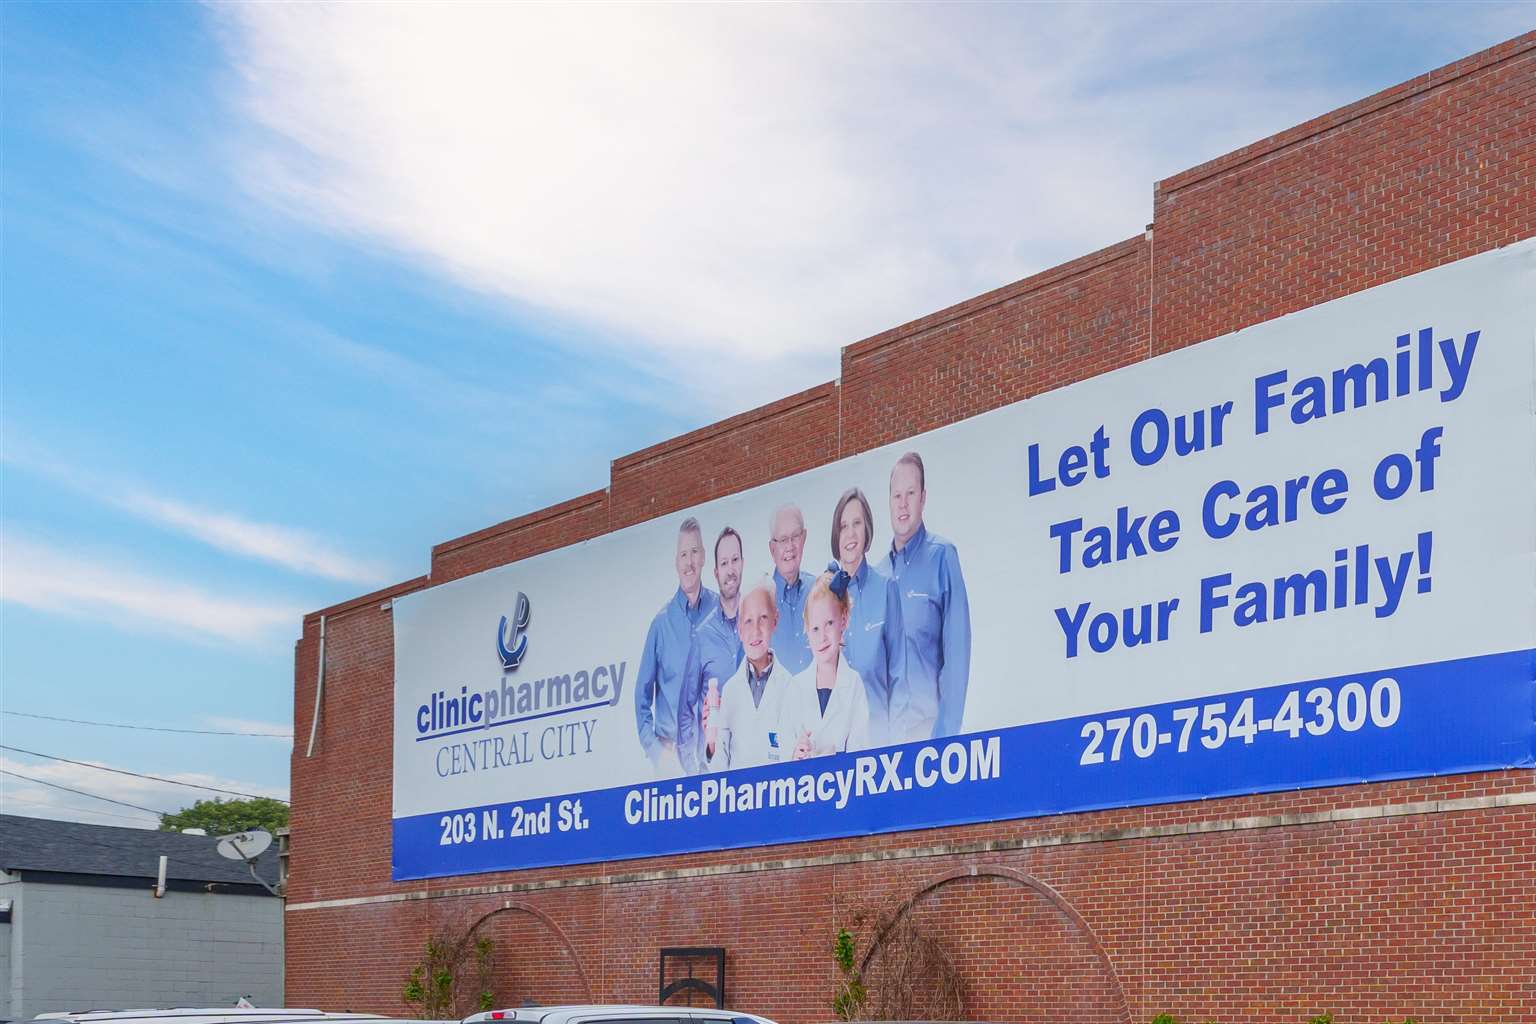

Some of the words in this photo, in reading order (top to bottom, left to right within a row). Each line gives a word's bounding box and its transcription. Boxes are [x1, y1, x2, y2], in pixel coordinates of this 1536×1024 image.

[1028, 426, 1110, 496] Let
[1130, 401, 1232, 465] Our
[1254, 327, 1480, 433] Family
[1050, 507, 1180, 573] Take
[1202, 469, 1349, 540] Care
[1373, 427, 1445, 501] of
[1056, 598, 1179, 657] Your
[1200, 531, 1433, 633] Family!
[417, 660, 626, 733] clinicpharmacy
[1080, 678, 1400, 765] 270-754-4300
[436, 731, 534, 777] CENTRAL
[541, 719, 597, 760] CITY
[625, 737, 1000, 824] ClinicPharmacyRX.COM
[440, 813, 475, 845] 203
[483, 810, 503, 840] N.
[511, 803, 550, 836] 2nd
[558, 800, 588, 831] St.
